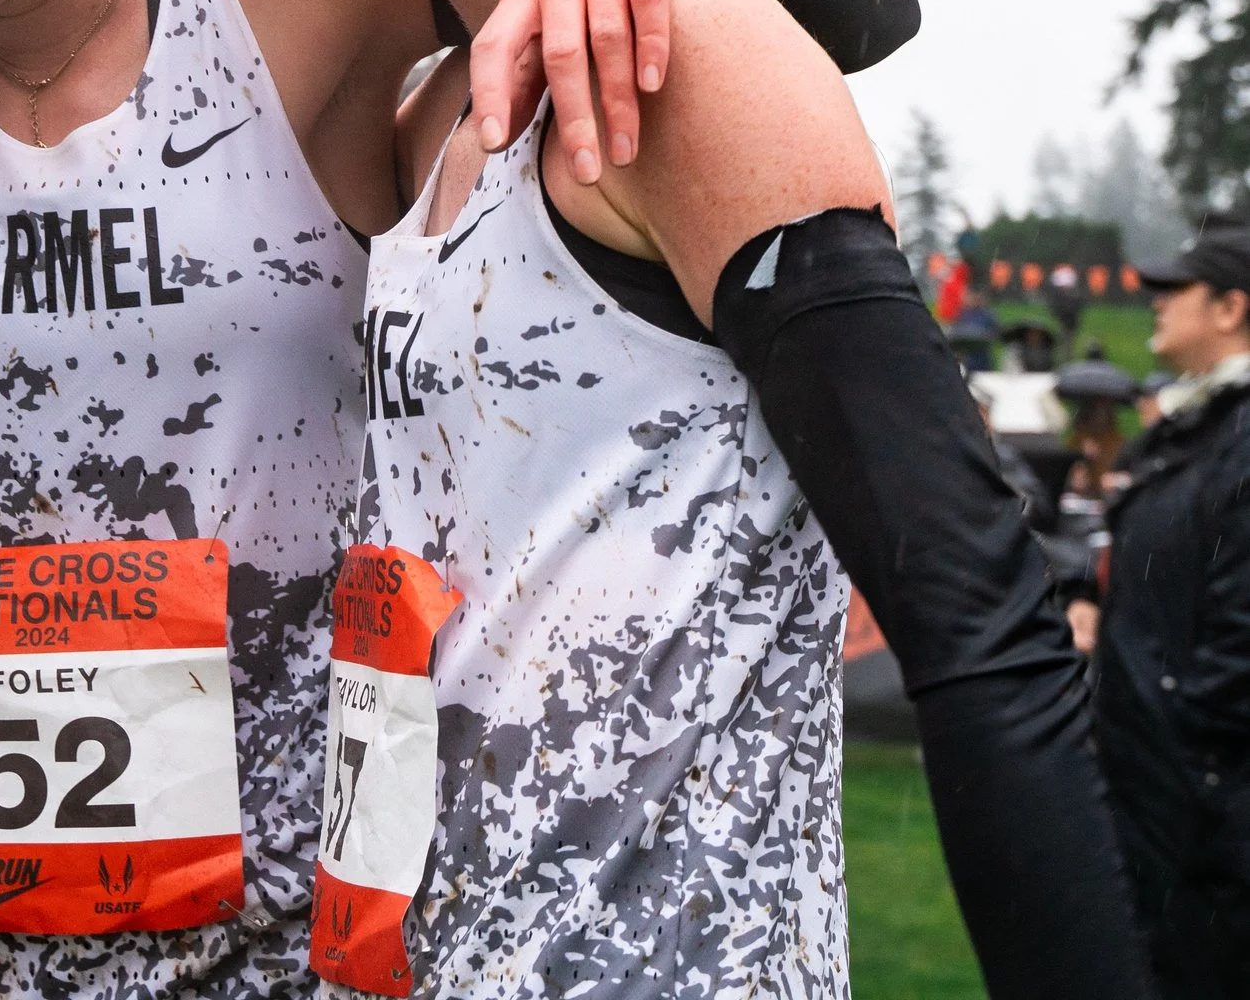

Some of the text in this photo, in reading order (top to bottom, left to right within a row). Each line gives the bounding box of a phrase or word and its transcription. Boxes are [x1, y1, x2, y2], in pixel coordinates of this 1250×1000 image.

[29, 551, 169, 587] CROSS
[15, 627, 70, 647] 2024
[336, 676, 377, 714] TAYLOR
[94, 902, 142, 915] USATF
